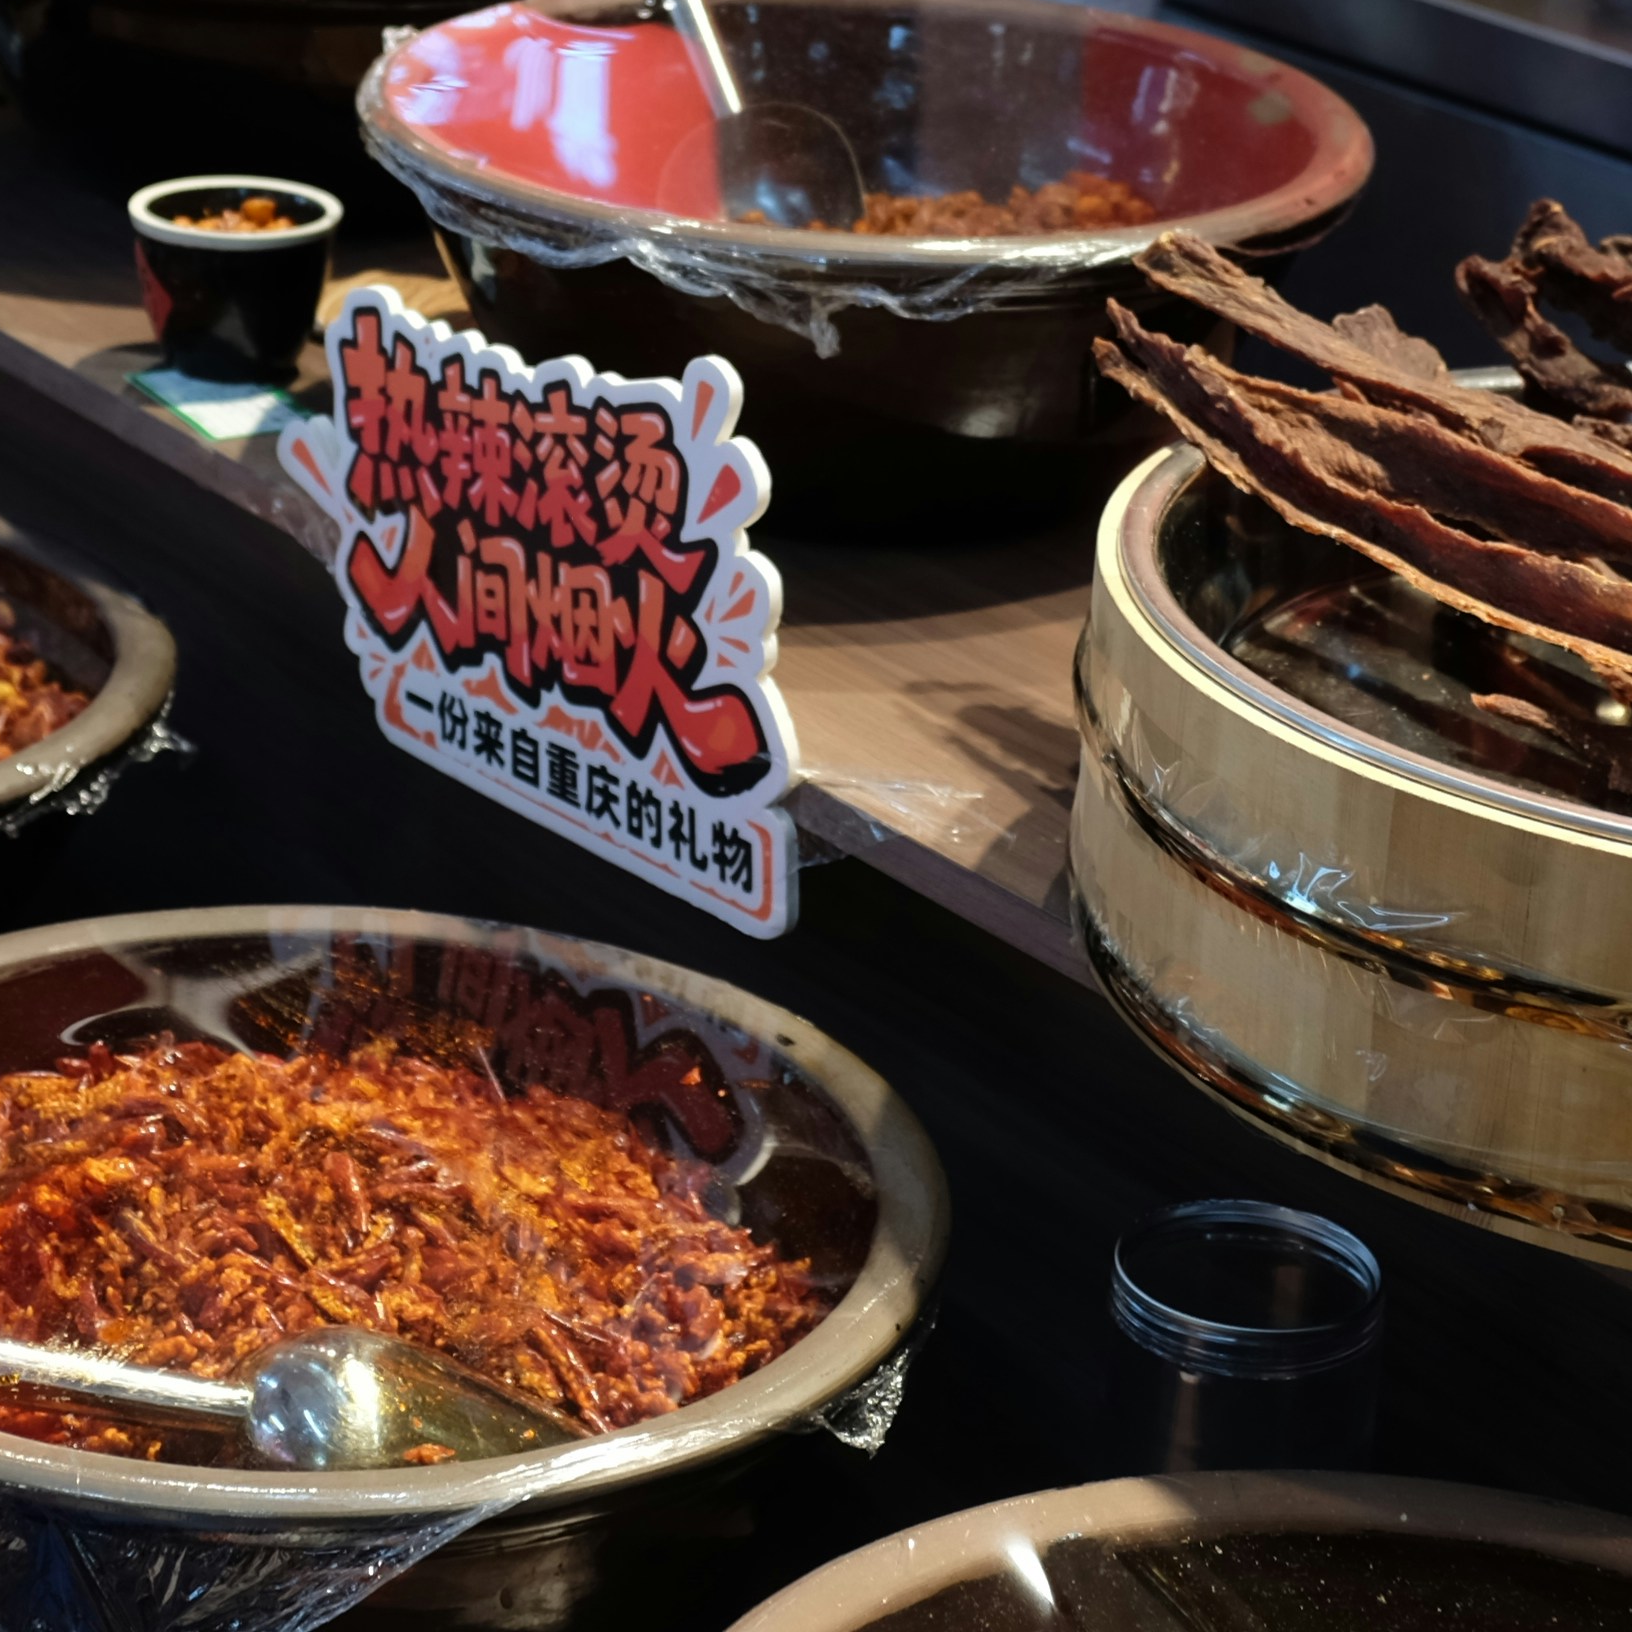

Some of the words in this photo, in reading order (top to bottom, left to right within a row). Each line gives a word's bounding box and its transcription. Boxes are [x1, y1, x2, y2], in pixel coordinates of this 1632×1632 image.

[340, 309, 706, 594] 热辣滚烫
[347, 504, 768, 774] 人间烟火
[404, 687, 755, 892] 一份来自重庆的礼物
